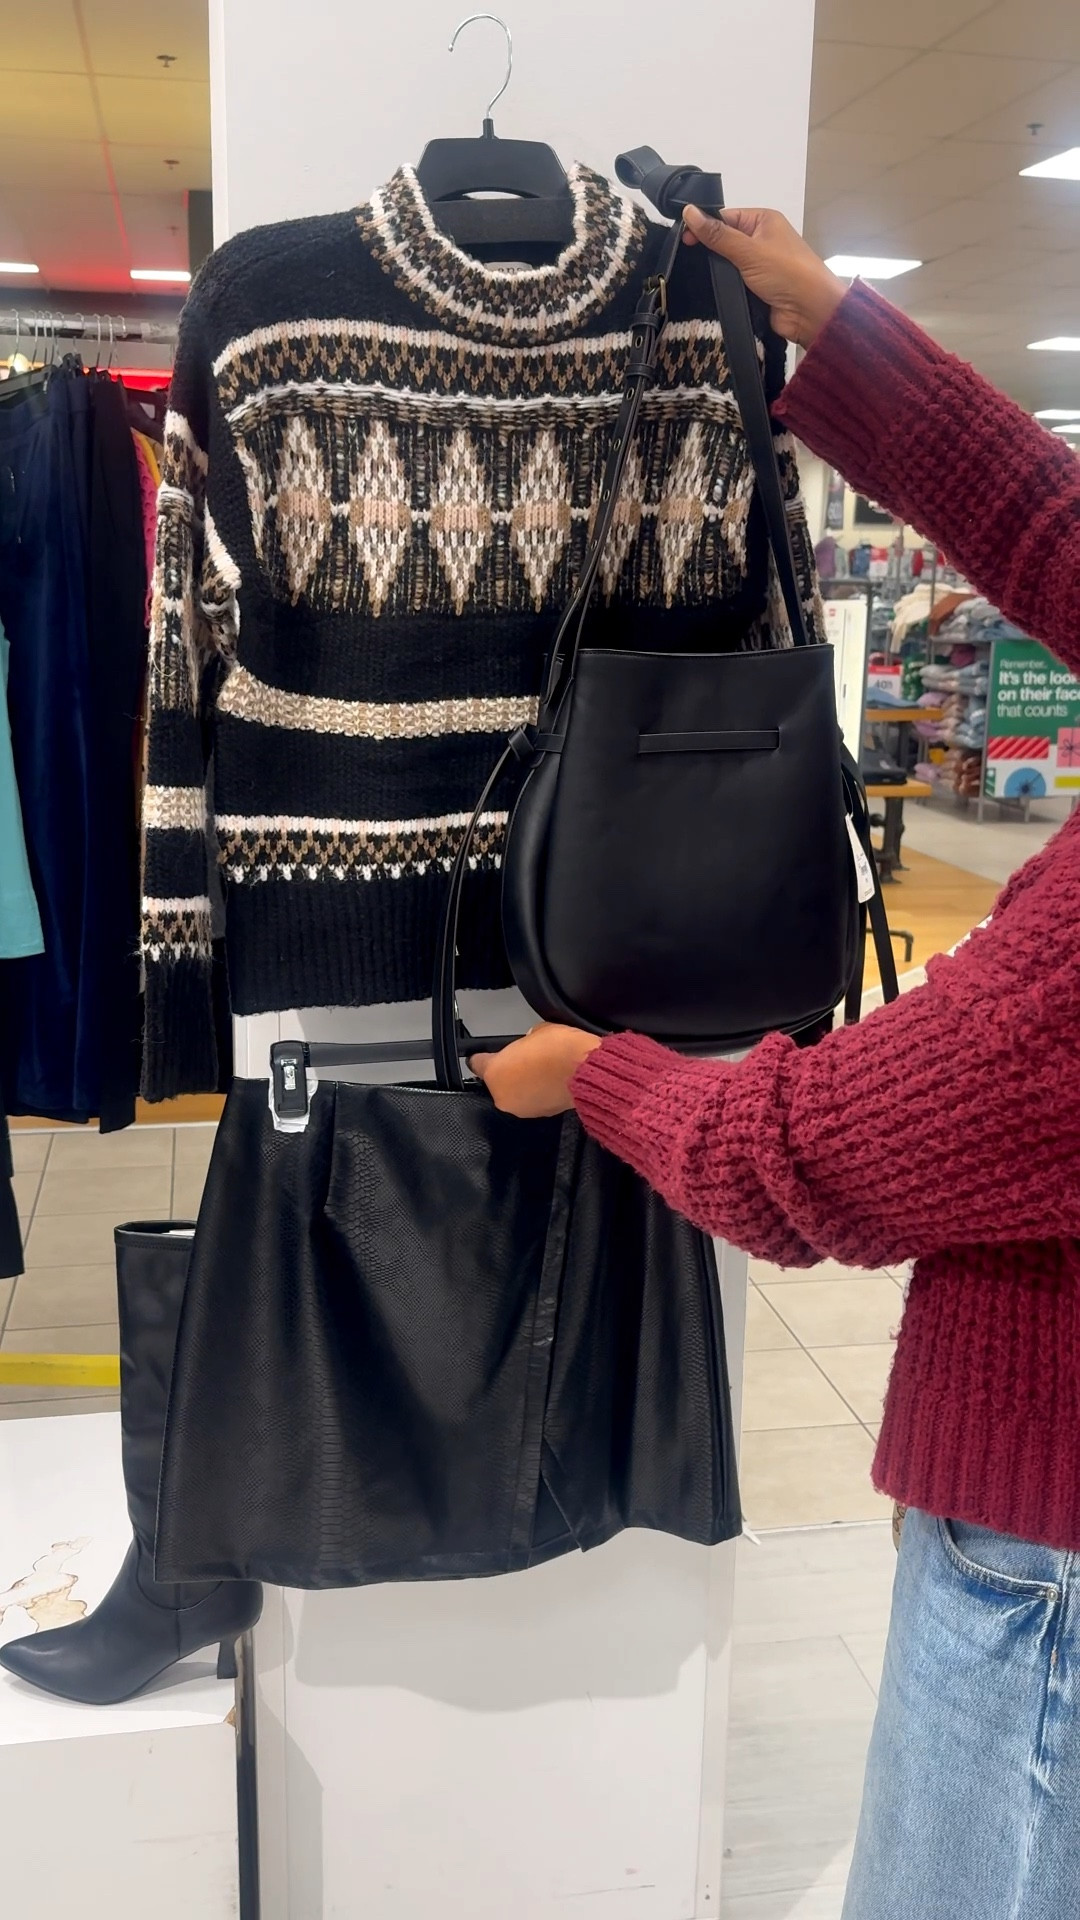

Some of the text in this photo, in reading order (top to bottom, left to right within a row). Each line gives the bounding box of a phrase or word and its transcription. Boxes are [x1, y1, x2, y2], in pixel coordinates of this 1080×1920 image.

[999, 671, 1019, 685] It's
[1023, 671, 1046, 685] the
[997, 690, 1016, 701] on
[1020, 687, 1052, 701] their
[997, 704, 1068, 717] that counts
